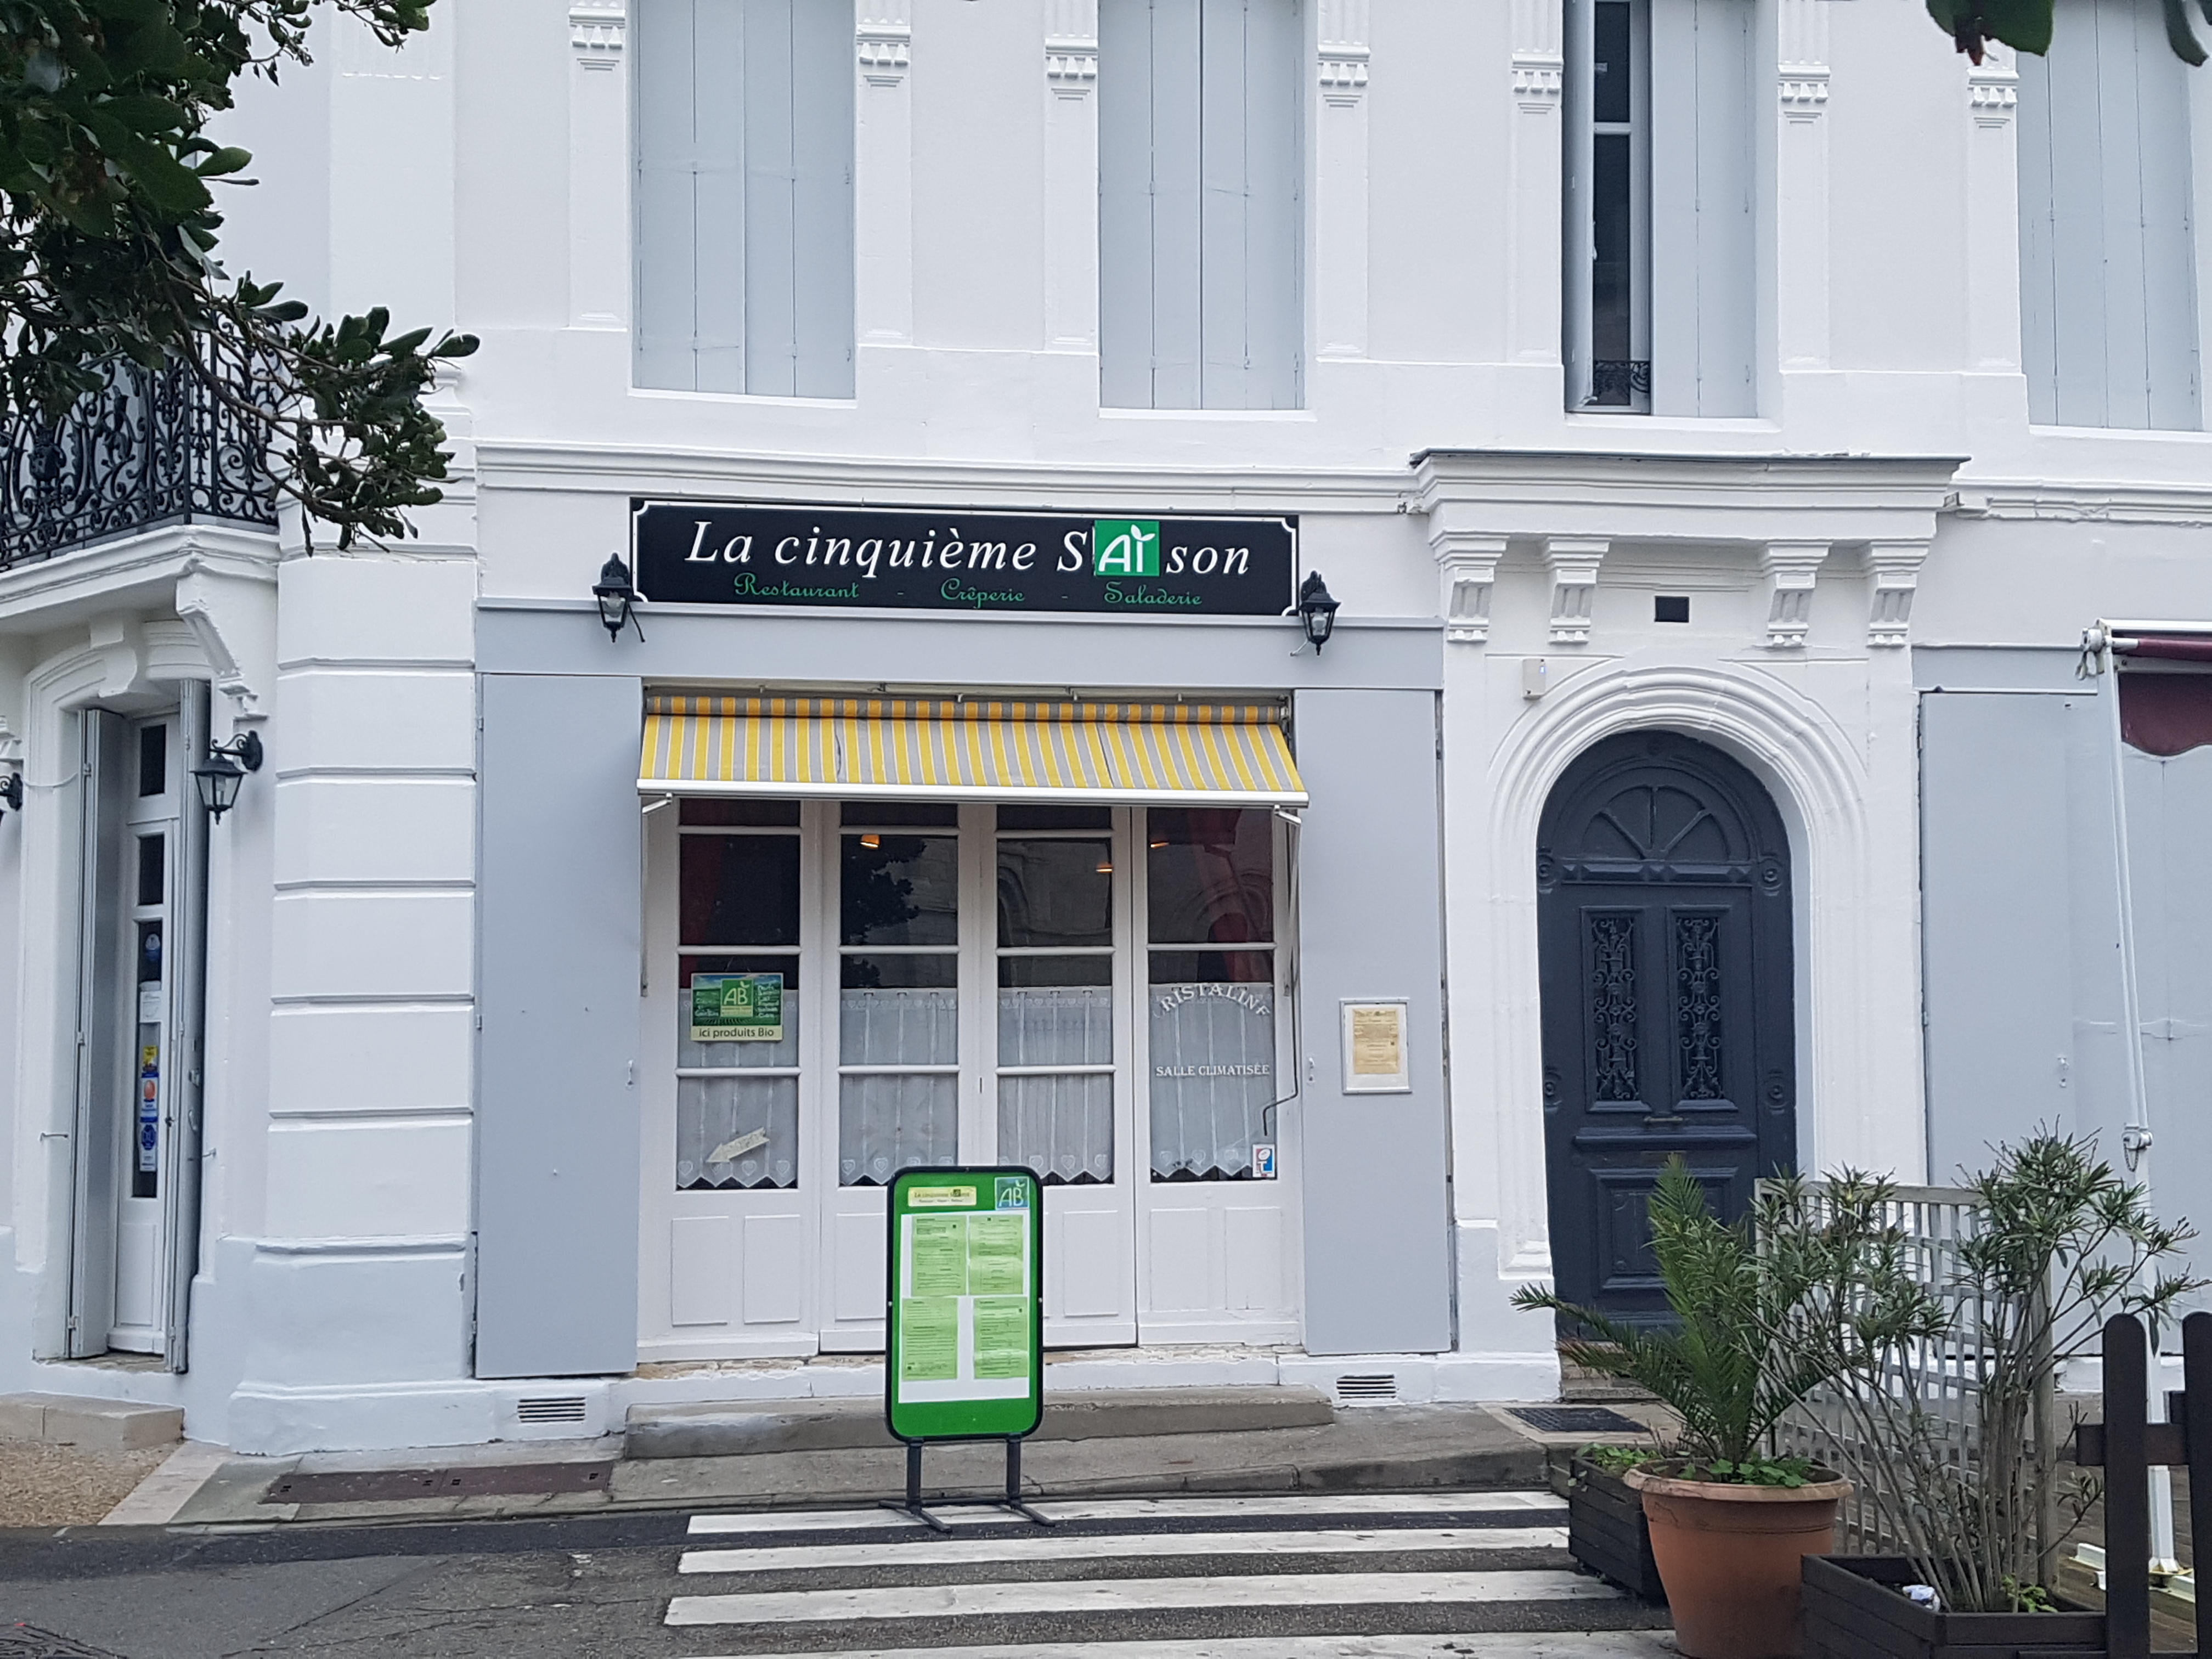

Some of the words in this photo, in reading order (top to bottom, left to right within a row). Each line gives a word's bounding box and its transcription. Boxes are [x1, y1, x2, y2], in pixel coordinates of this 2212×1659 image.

[685, 521, 753, 563] La
[775, 526, 1036, 578] cinquième
[733, 572, 859, 598] Restaurant
[940, 578, 1025, 609] Crêperie
[1104, 582, 1202, 605] Saladerie
[724, 986, 749, 1005] AB
[699, 1028, 710, 1037] ici
[714, 1028, 755, 1038] produits
[758, 1028, 774, 1037] Bio
[1156, 1065, 1195, 1076] SALLE
[998, 1187, 1024, 1207] AB
